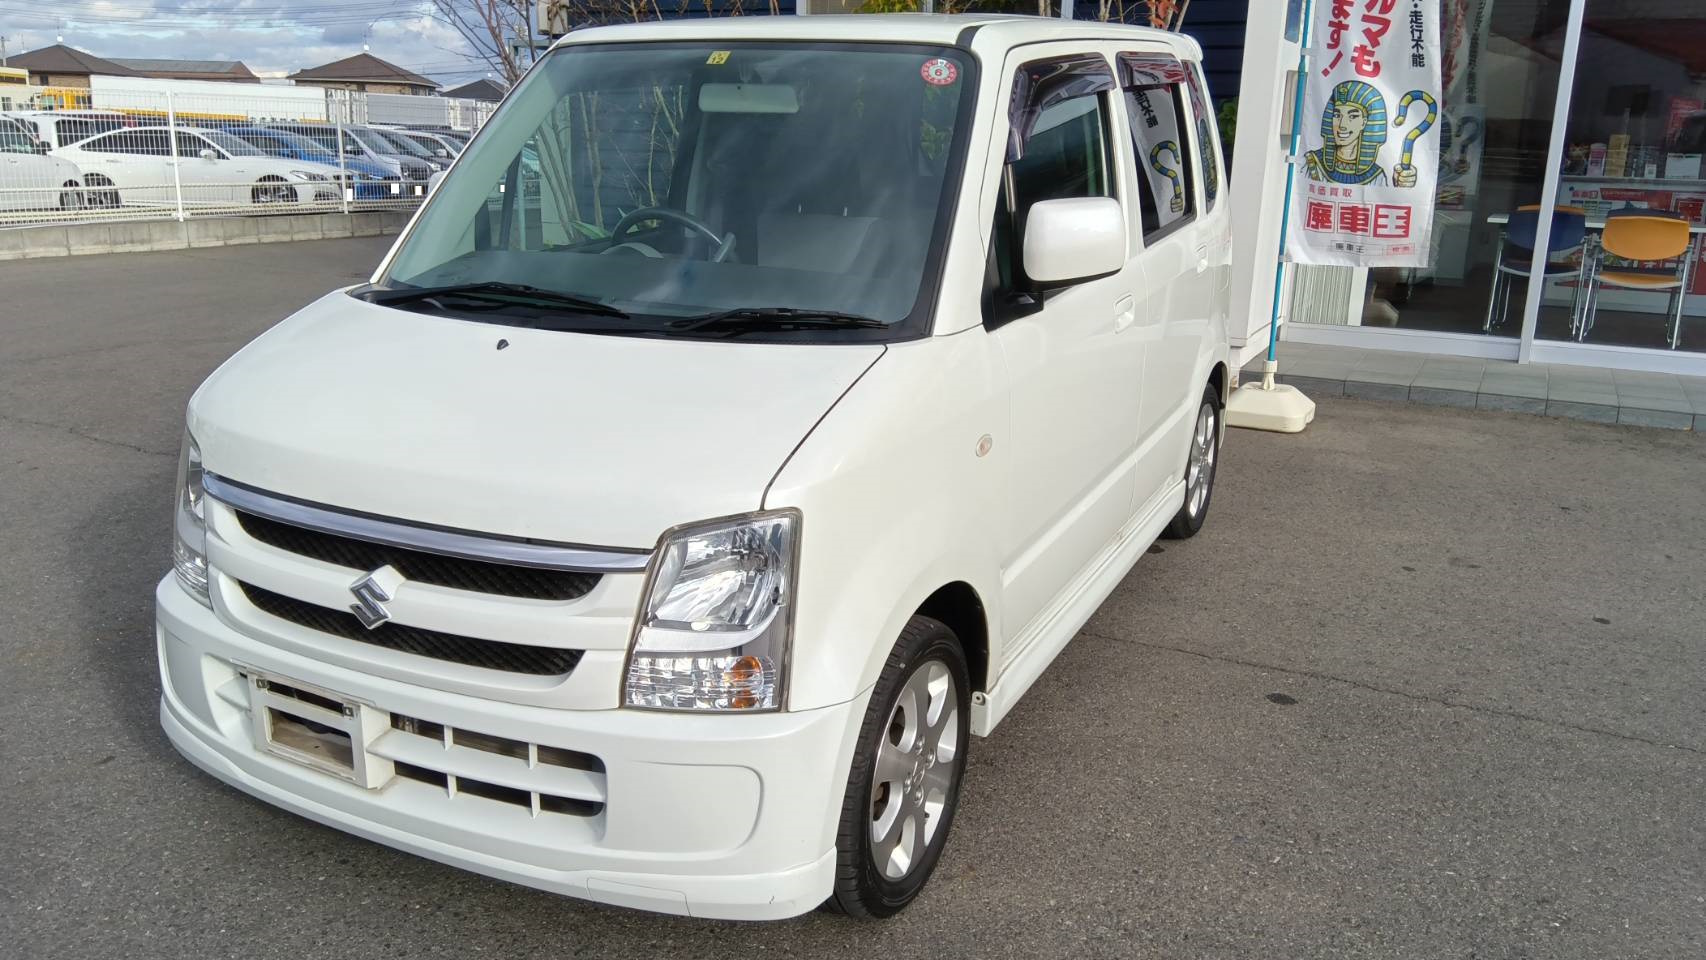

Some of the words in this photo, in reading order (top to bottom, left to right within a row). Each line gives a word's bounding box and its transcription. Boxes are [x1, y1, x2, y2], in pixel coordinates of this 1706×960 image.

[1408, 0, 1426, 68] ・走行不能
